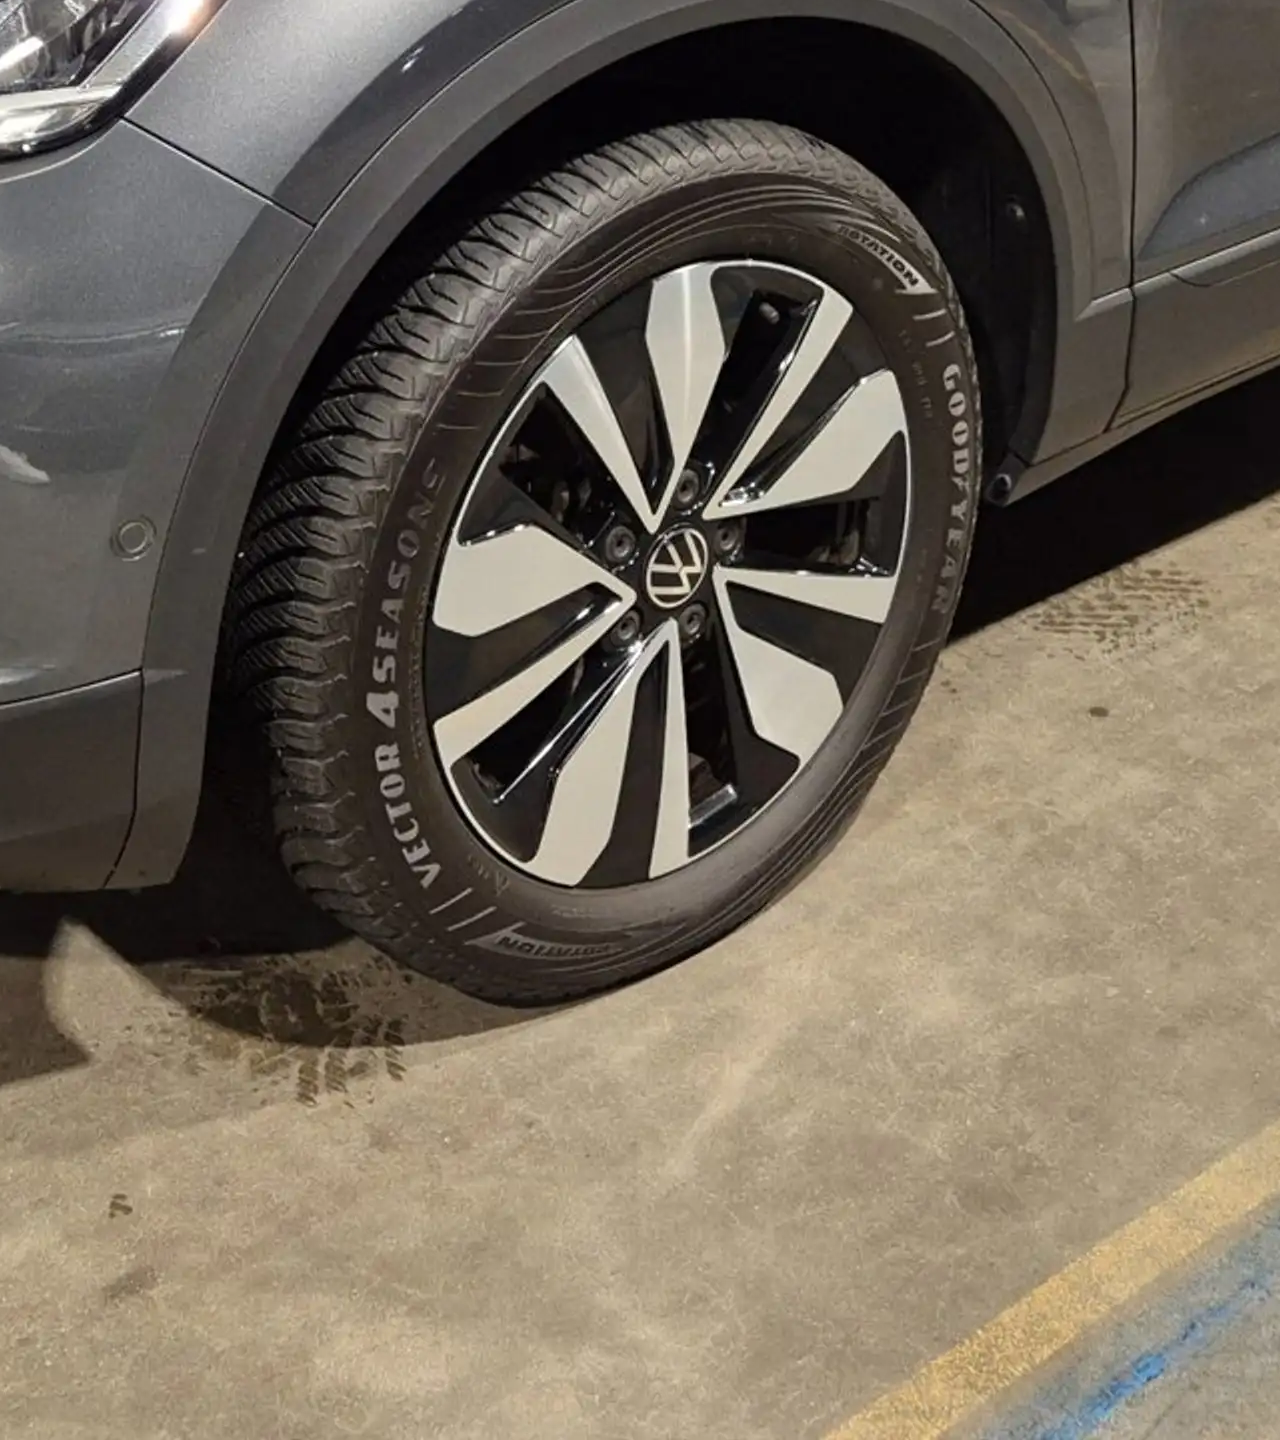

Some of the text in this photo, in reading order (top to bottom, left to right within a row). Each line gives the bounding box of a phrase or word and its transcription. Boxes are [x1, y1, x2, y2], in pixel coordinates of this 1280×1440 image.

[838, 224, 919, 286] ROTATION
[932, 363, 970, 613] GOODYEAR
[374, 742, 441, 888] VECTOR
